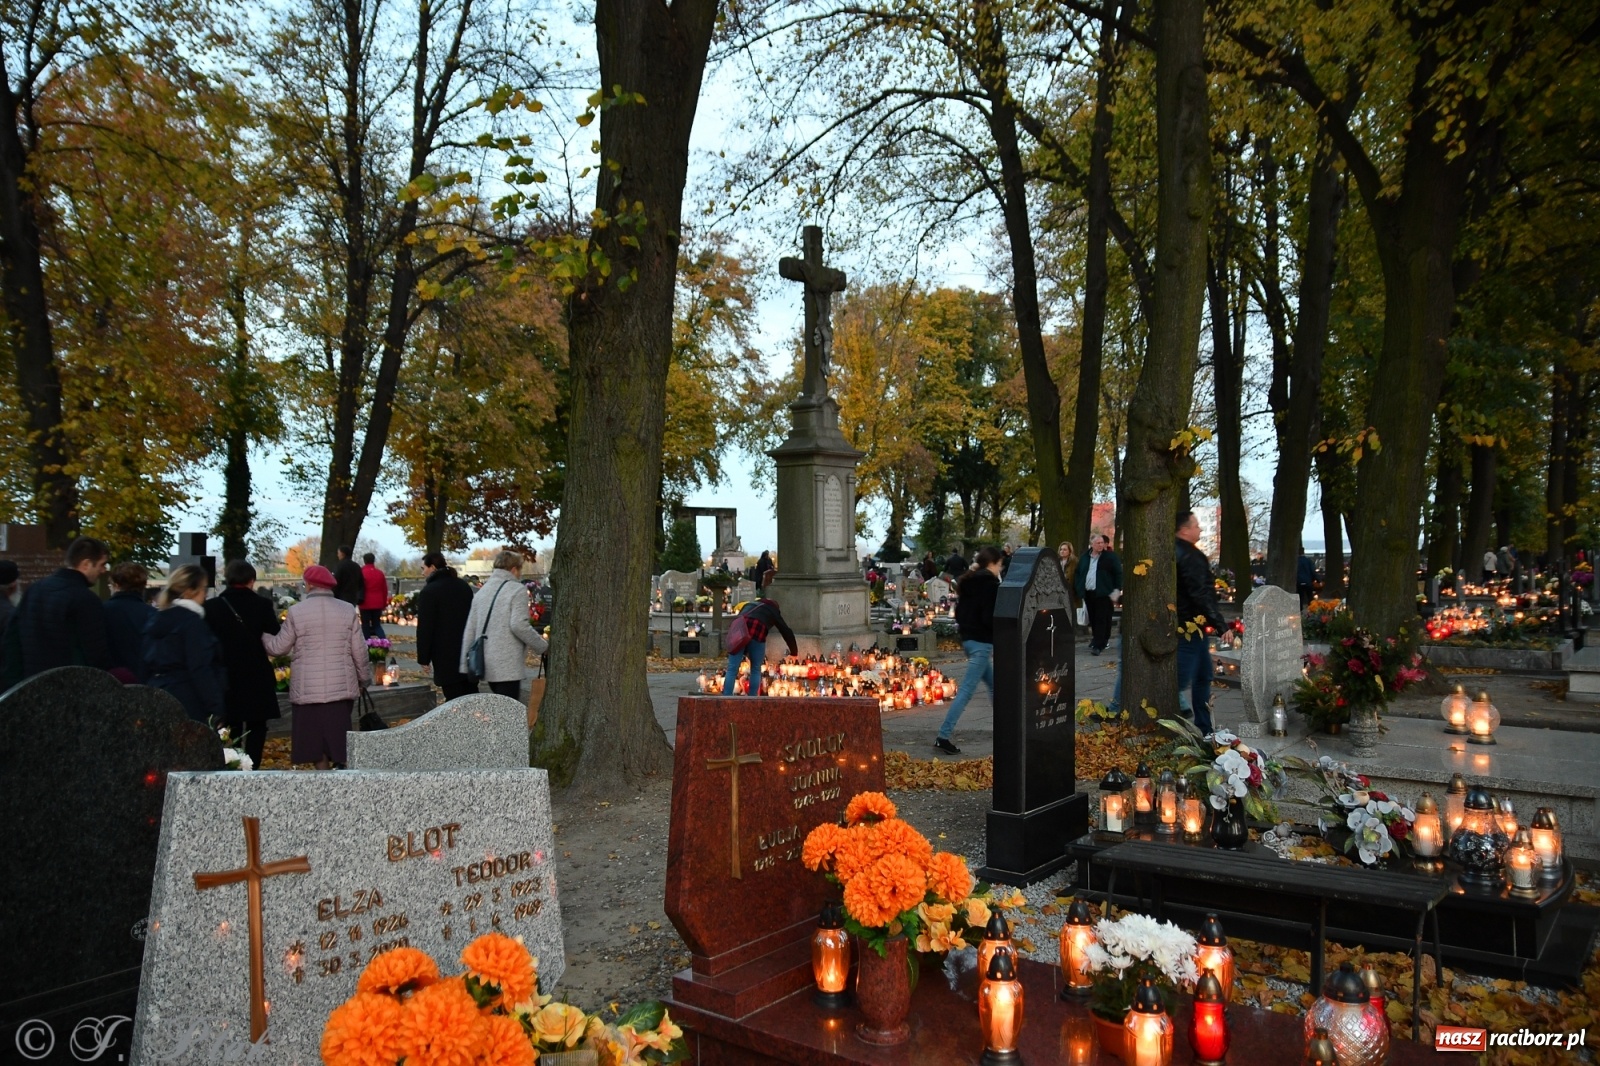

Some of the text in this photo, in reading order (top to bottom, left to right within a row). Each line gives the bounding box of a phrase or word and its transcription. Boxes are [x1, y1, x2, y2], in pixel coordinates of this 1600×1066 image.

[784, 733, 845, 763] SADLOK
[790, 767, 843, 792] JOANNA
[387, 822, 461, 862] BLOT
[451, 851, 531, 887] TEODOR
[317, 887, 384, 922] ELZA
[514, 898, 544, 921] 1969
[320, 931, 338, 951] 12
[373, 912, 409, 936] 1926
[319, 956, 342, 977] 30
